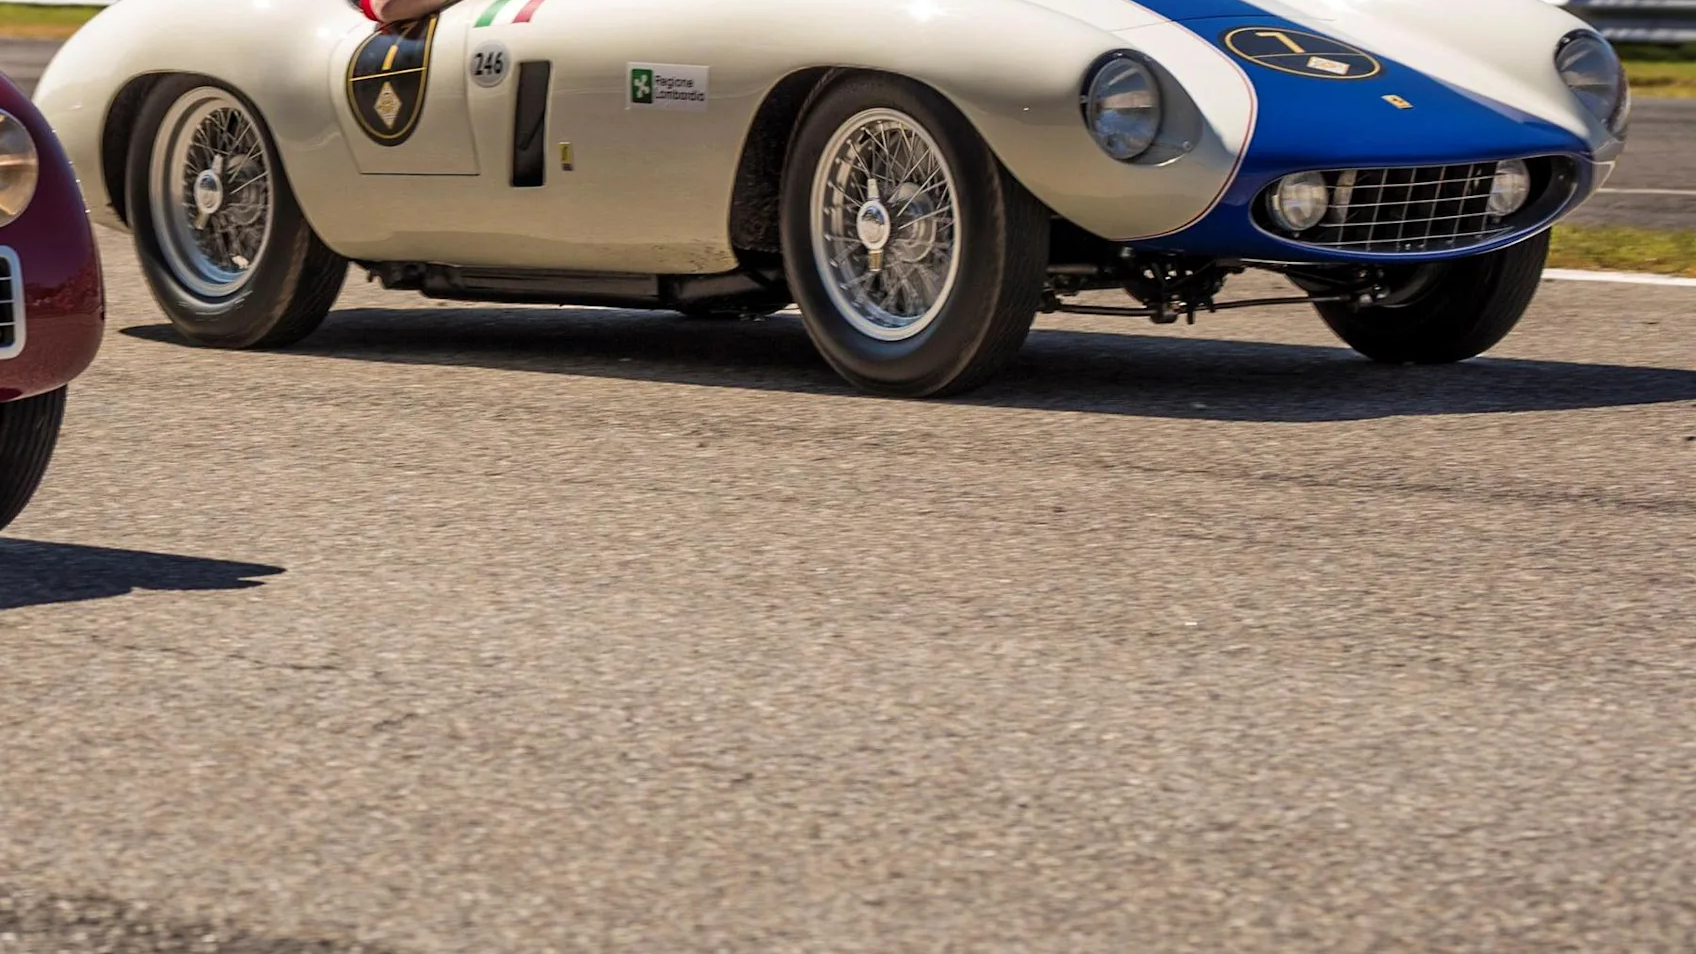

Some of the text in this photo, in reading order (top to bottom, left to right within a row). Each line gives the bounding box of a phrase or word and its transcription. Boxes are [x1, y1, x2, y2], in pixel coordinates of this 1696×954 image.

[1255, 31, 1306, 54] 7
[474, 51, 505, 76] 246
[655, 74, 693, 89] Regione
[655, 88, 705, 101] Lombardia
